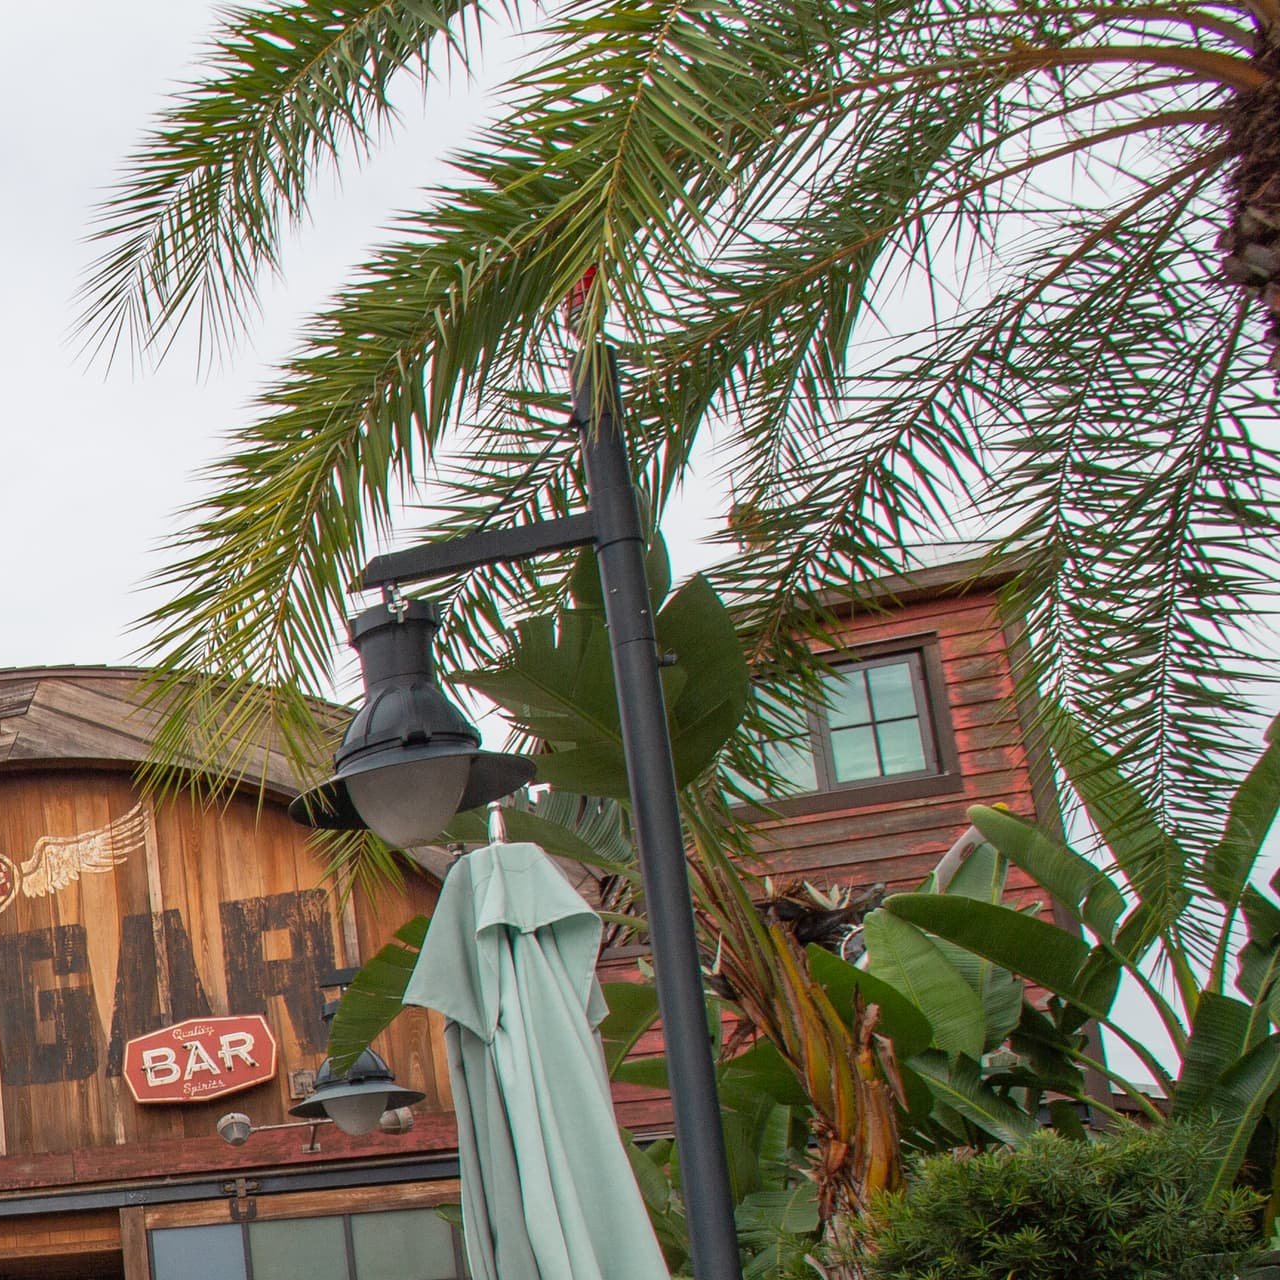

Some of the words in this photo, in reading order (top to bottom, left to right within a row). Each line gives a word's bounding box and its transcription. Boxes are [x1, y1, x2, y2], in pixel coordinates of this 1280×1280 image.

[172, 1025, 215, 1041] Quality
[141, 1031, 260, 1087] BAR
[183, 1079, 226, 1096] Spirits
